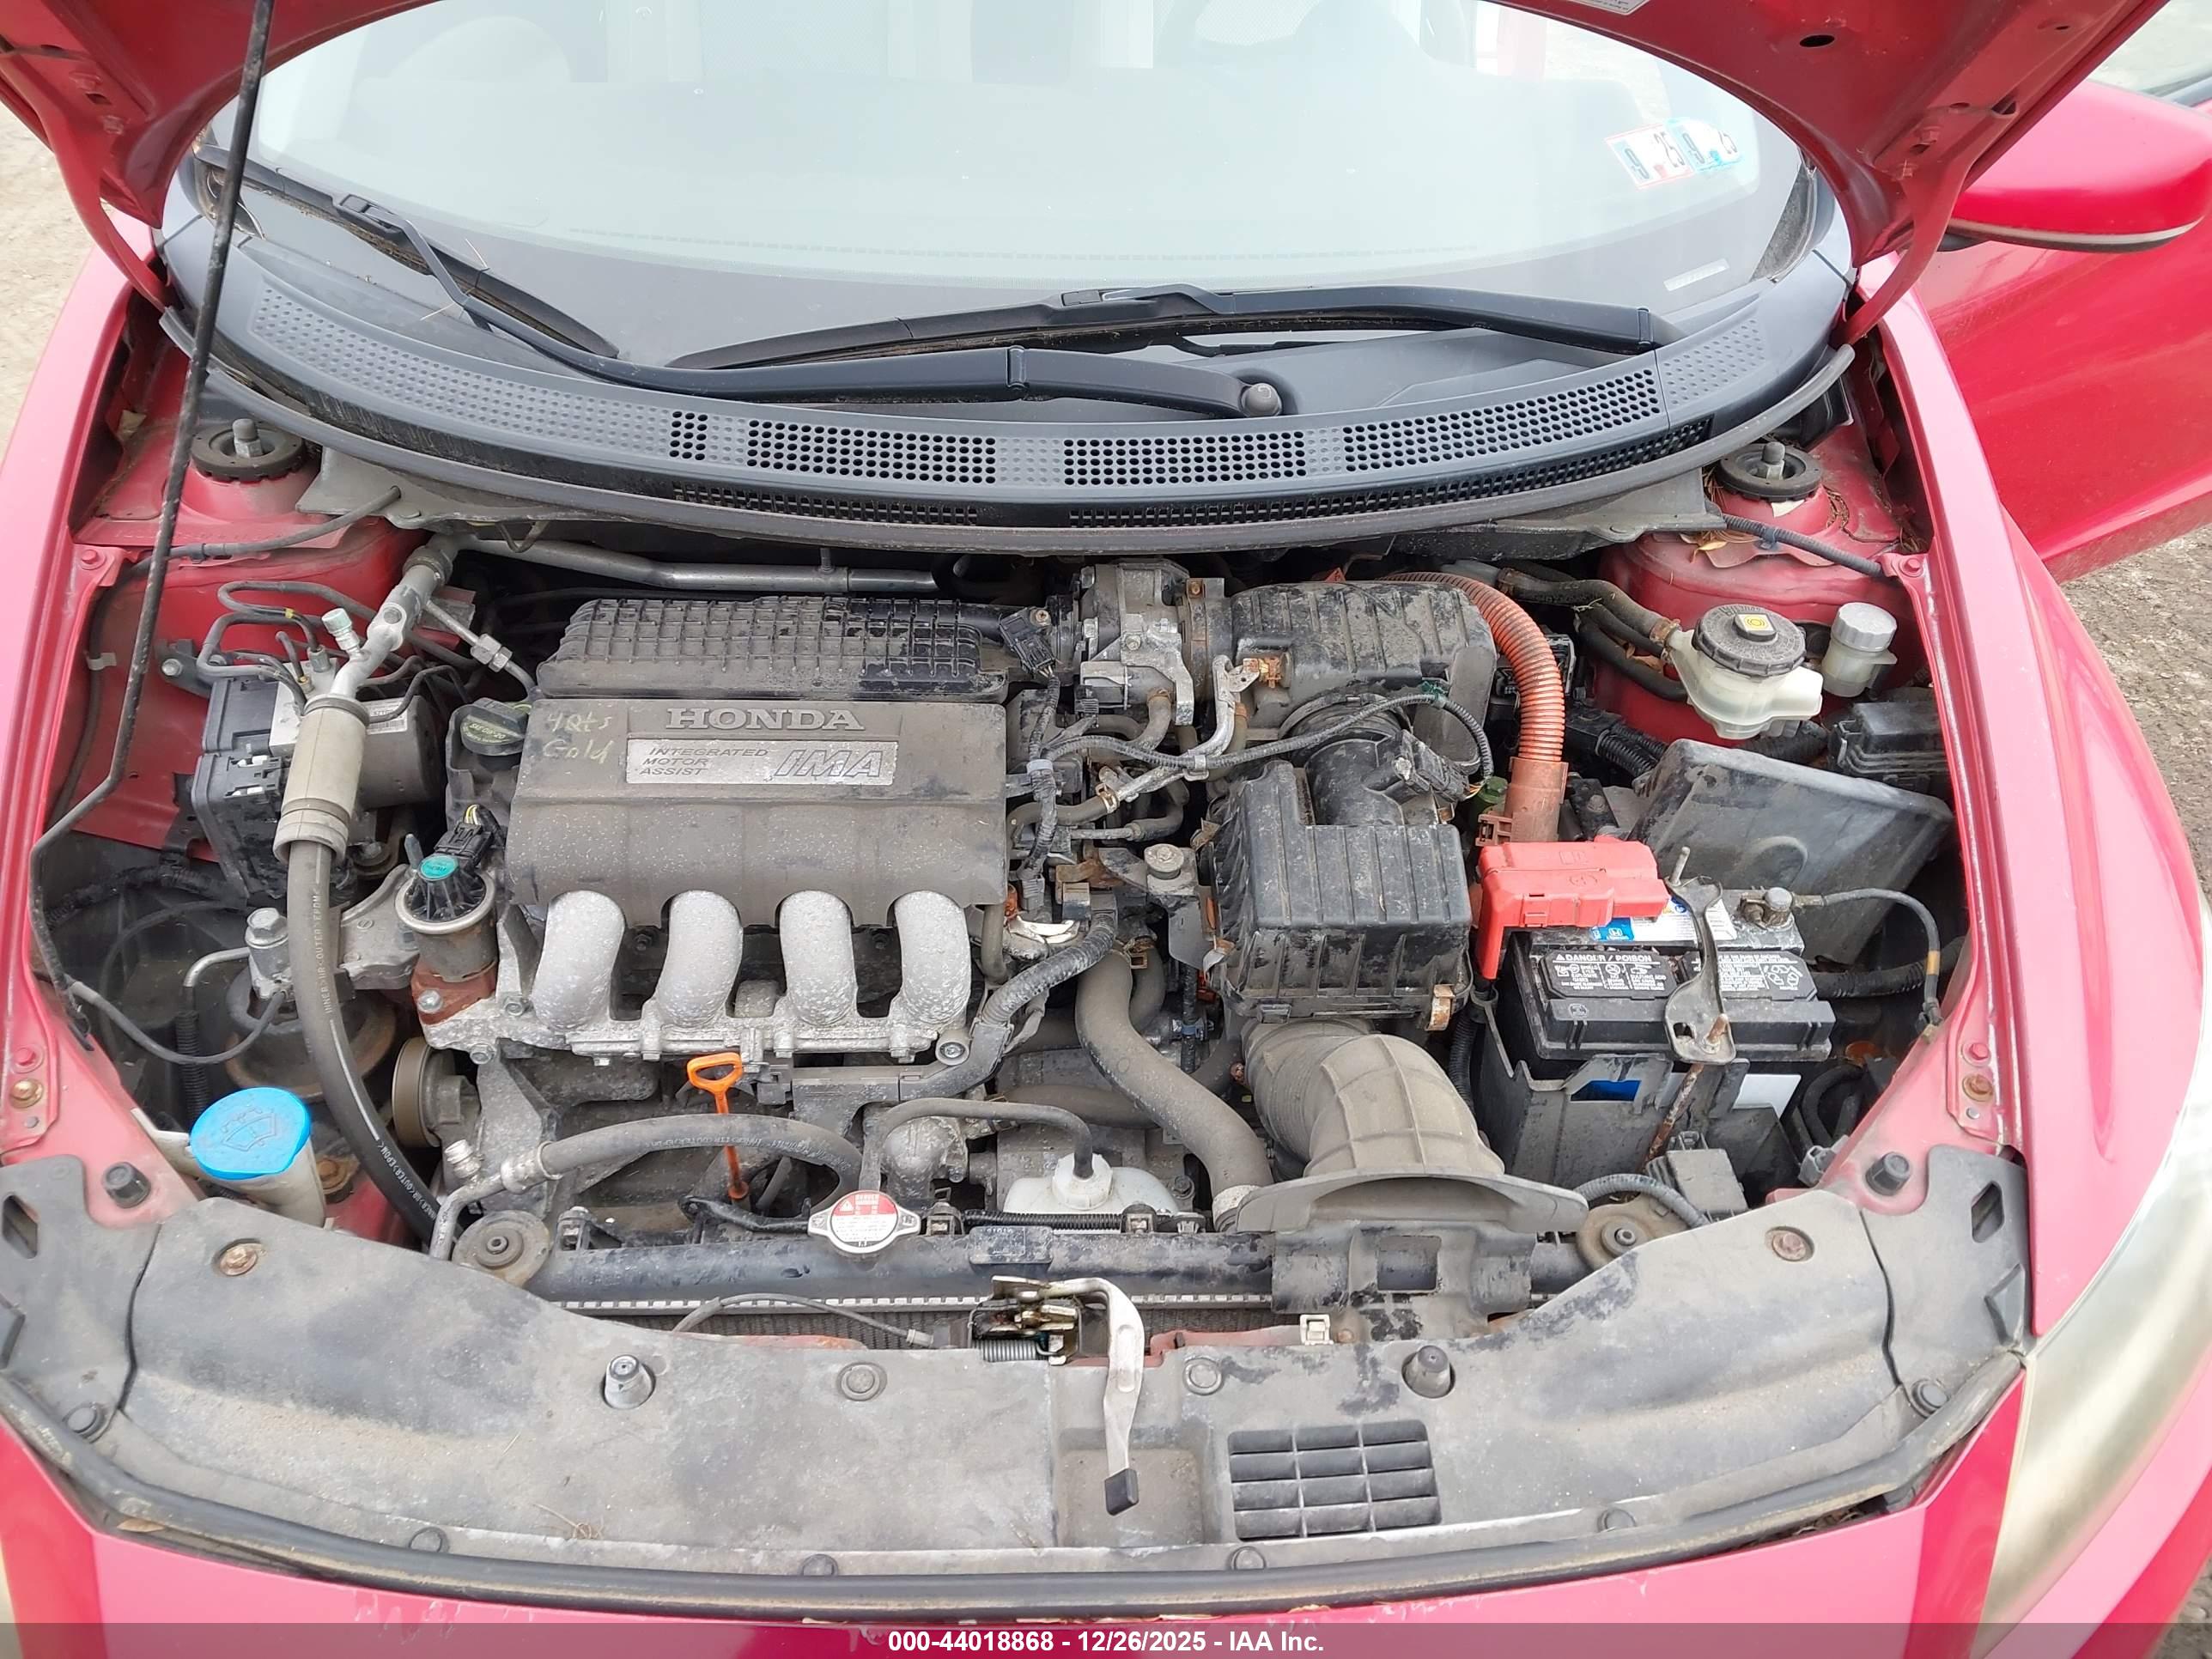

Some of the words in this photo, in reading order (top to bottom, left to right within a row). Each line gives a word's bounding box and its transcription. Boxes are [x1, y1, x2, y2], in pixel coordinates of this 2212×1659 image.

[665, 708, 866, 731] HONDA
[542, 738, 614, 764] Gold
[648, 747, 769, 757] INTEGRATED
[642, 757, 709, 766] MOTOR
[774, 749, 884, 778] IMA
[638, 767, 709, 776] ASSIST
[1615, 954, 1652, 963] POISON
